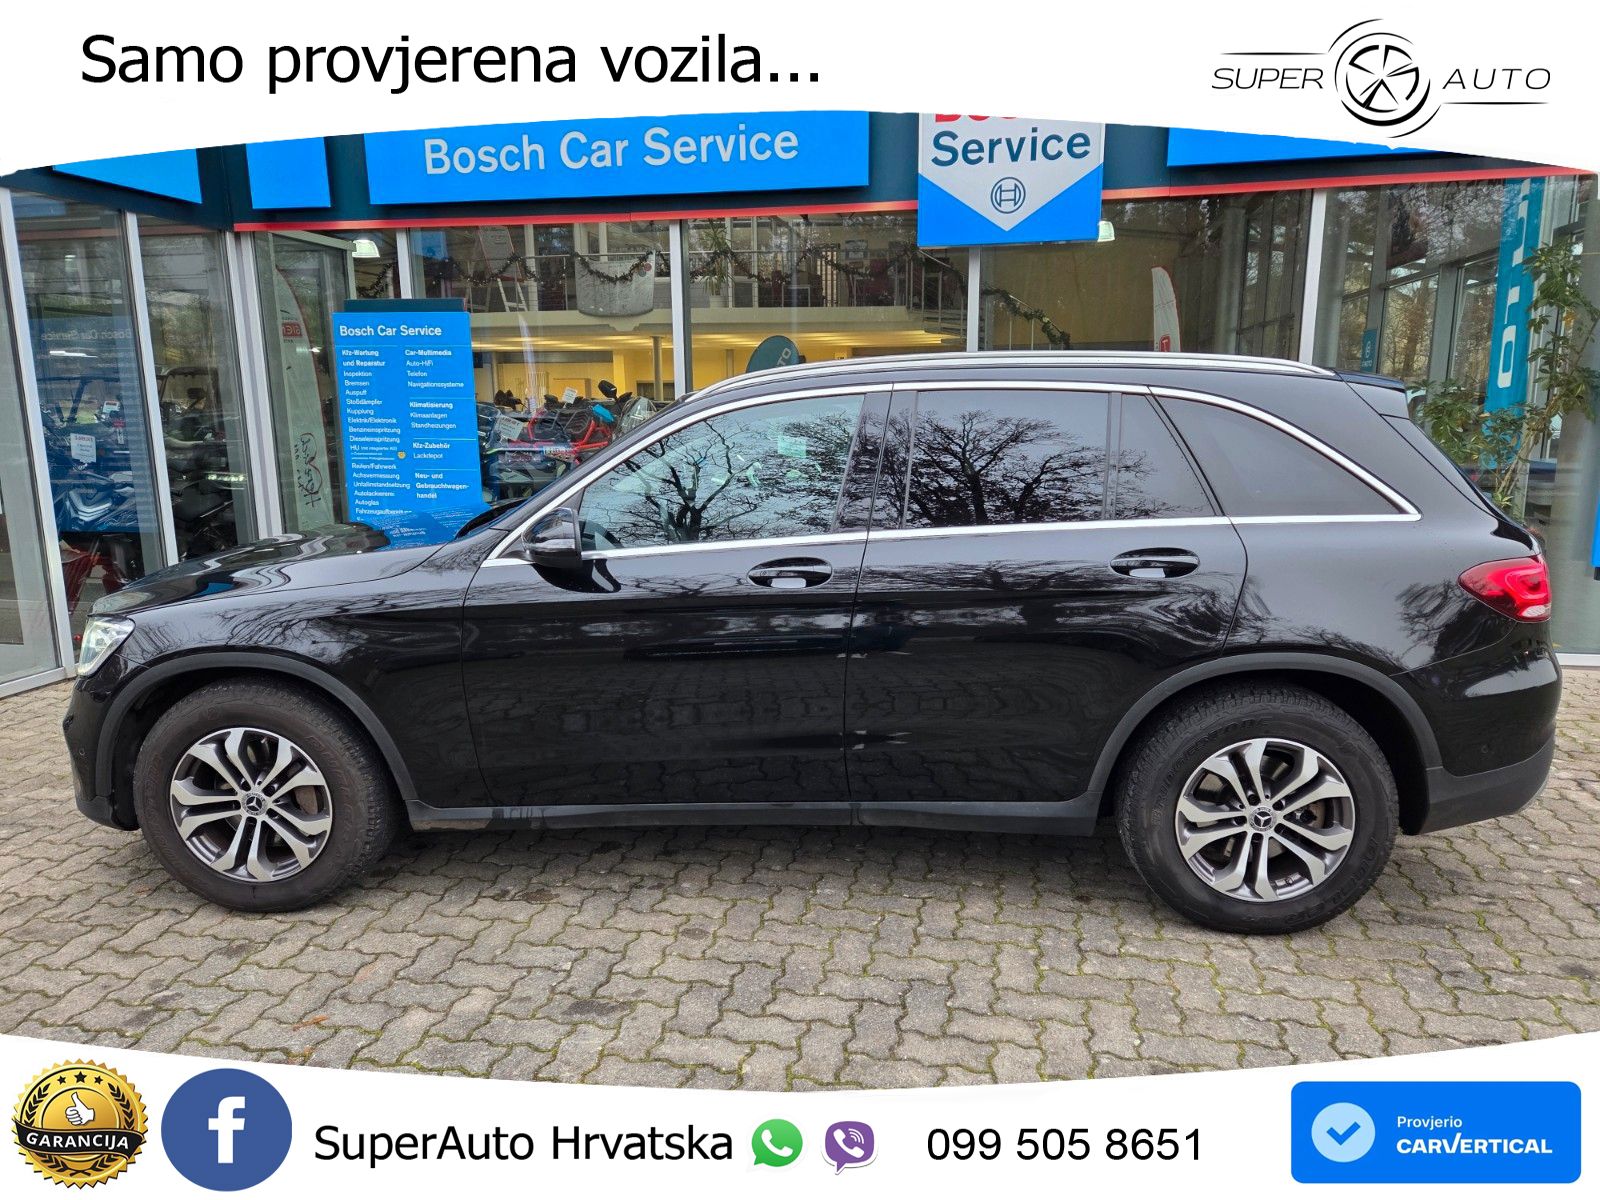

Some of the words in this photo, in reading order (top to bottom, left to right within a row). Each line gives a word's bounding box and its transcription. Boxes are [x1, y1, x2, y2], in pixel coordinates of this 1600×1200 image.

[424, 134, 545, 175] Bosch
[560, 131, 629, 170] Car
[642, 123, 799, 166] Service
[931, 127, 1091, 167] Service
[340, 325, 375, 336] Bosch
[377, 325, 397, 336] Car
[400, 325, 442, 336] Service
[342, 349, 379, 357] Kfz-Wartung
[408, 381, 464, 389] Navigationssysteme
[345, 389, 367, 397] Auspuff
[409, 401, 453, 410] Klimatisierung
[411, 422, 457, 430] Standheizungen
[415, 482, 470, 491] Gebrauchtwagen-
[355, 499, 379, 507] Autoglas
